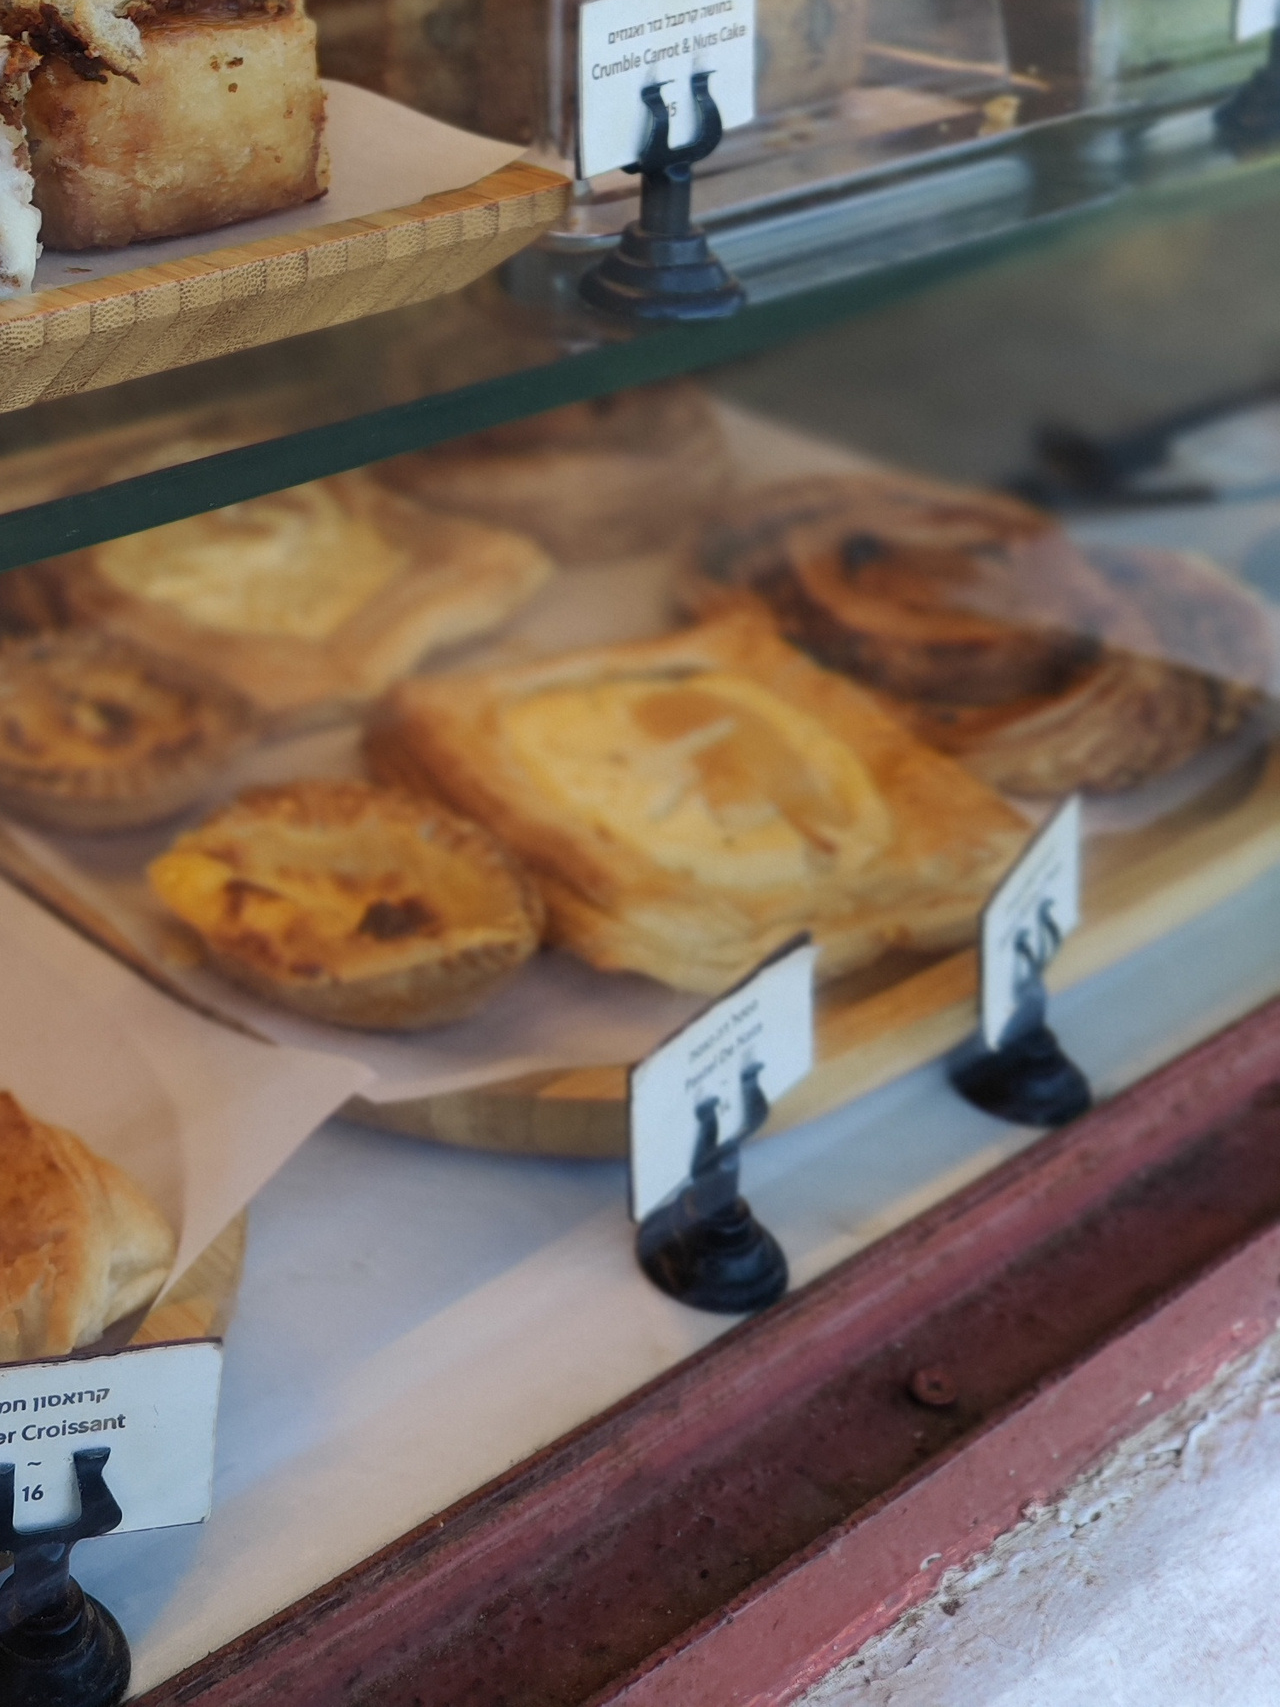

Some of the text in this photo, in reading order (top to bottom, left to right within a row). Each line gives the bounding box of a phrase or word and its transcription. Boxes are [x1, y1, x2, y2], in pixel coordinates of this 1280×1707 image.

[665, 8, 699, 29] קרמבל
[591, 22, 746, 81] Crumble Carrot & Nuts Cake
[33, 1388, 111, 1413] קרואסון
[21, 1413, 127, 1441] Croissant
[21, 1484, 45, 1502] 16
